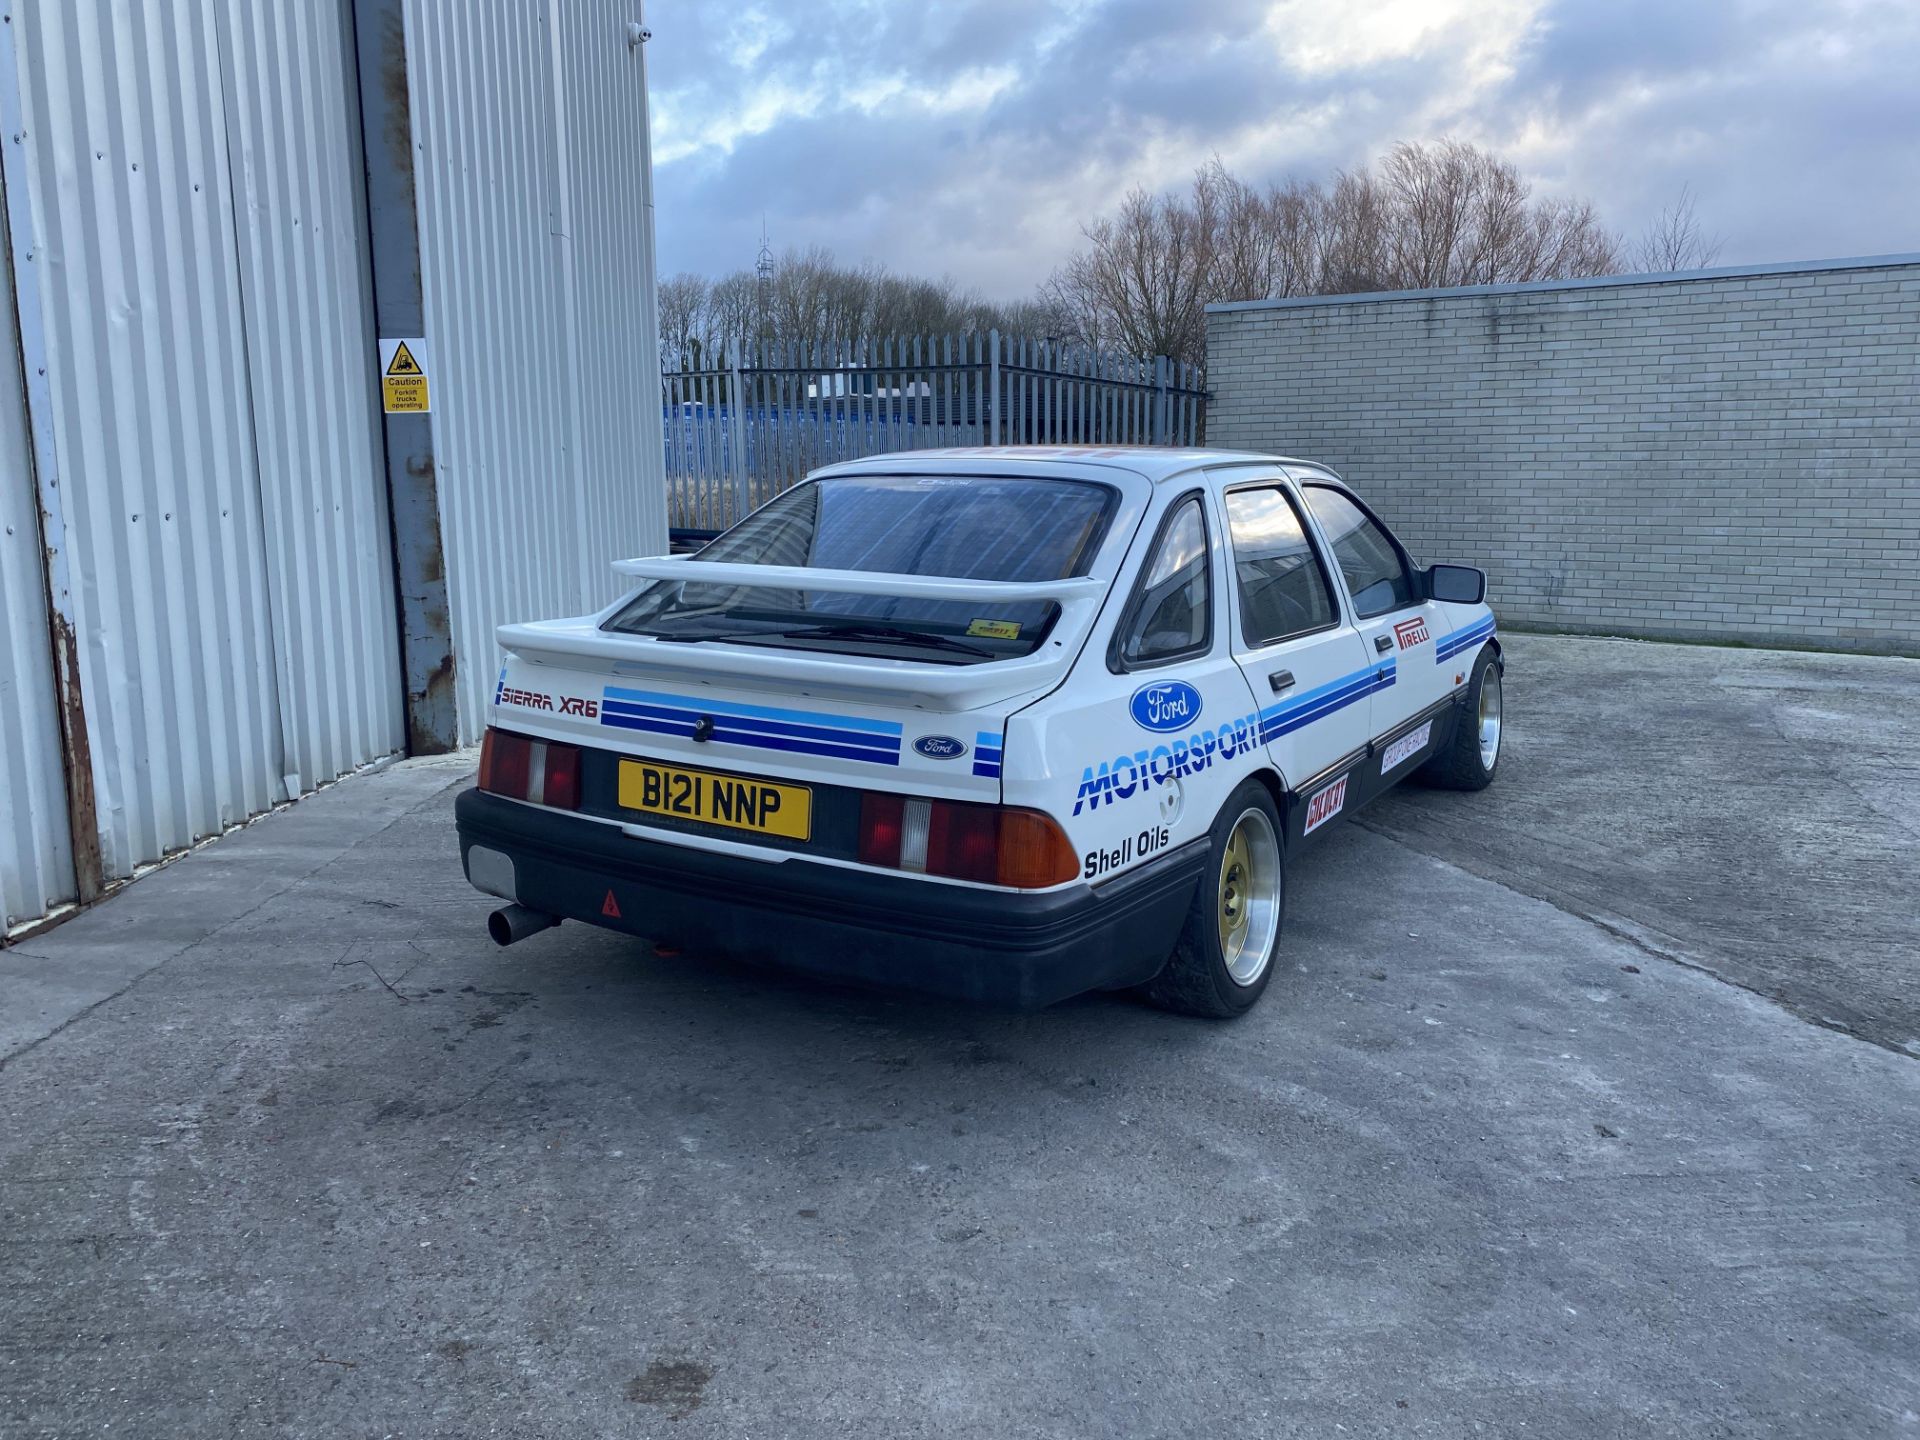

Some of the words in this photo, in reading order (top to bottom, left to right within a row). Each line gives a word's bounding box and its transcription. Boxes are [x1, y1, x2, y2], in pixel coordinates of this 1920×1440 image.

[388, 377, 423, 386] Caution
[391, 402, 423, 410] operating
[1393, 616, 1430, 651] PIRELLI
[501, 687, 554, 712] SIERRA
[558, 695, 598, 718] XR6
[1146, 685, 1190, 724] Ford
[924, 738, 953, 754] Ford
[1072, 712, 1258, 817] MOTORSPORT
[712, 779, 781, 828] NNP
[1084, 837, 1131, 880] Shell
[1137, 825, 1169, 858] Oils
